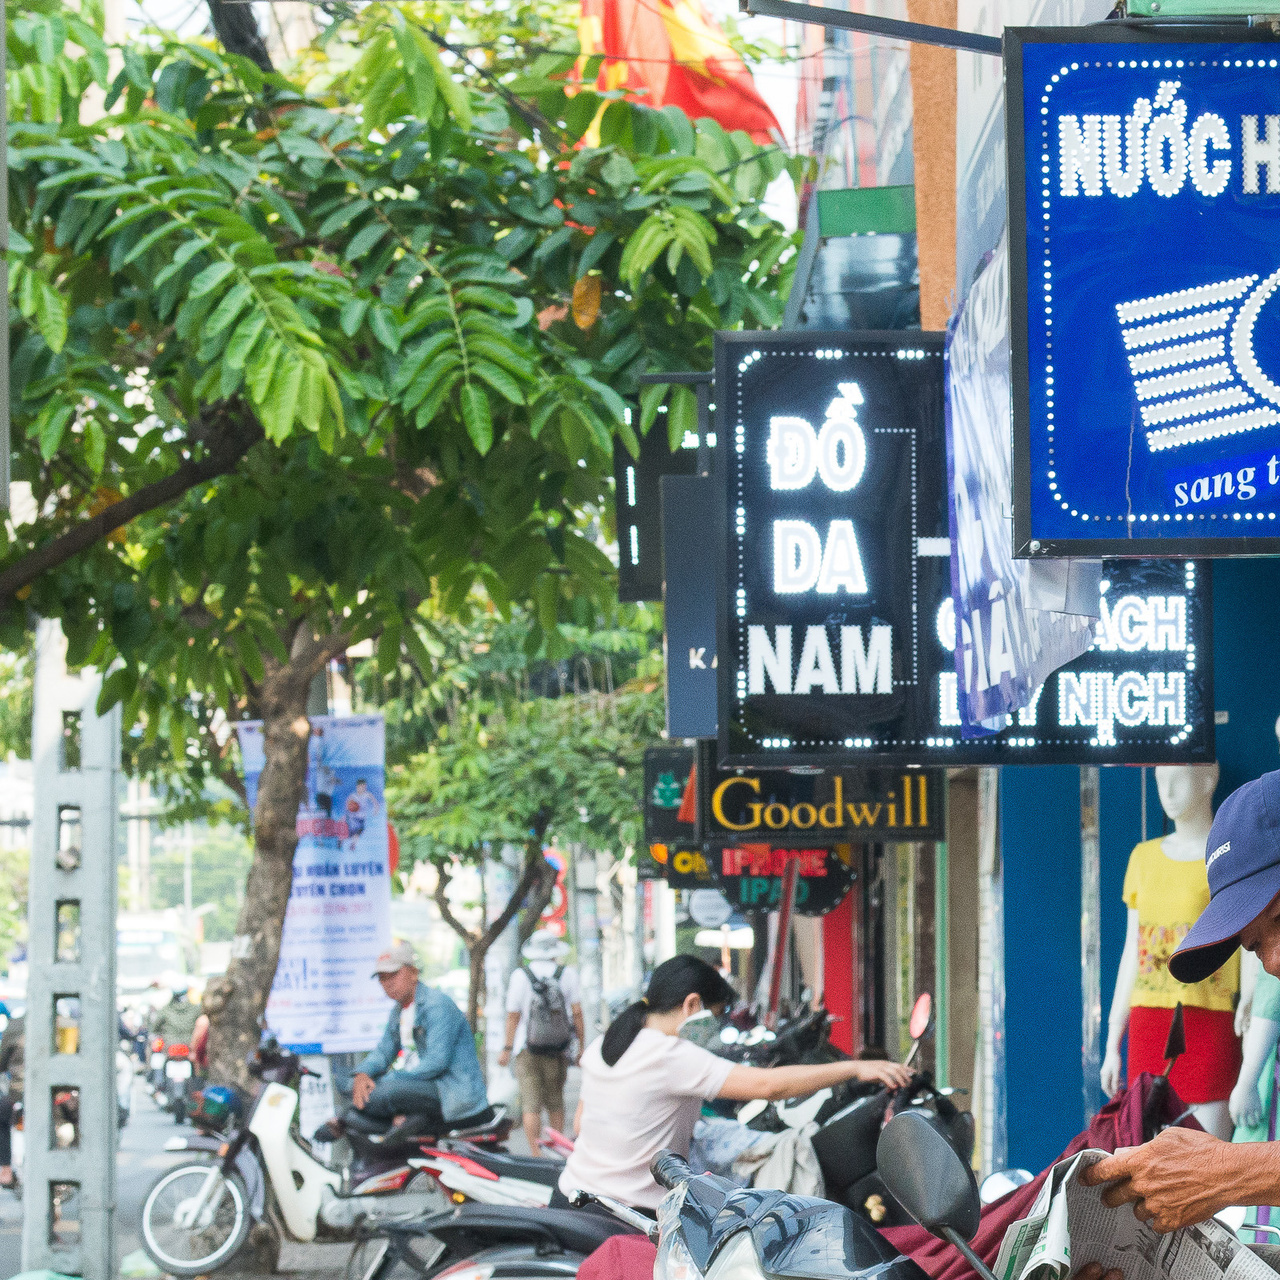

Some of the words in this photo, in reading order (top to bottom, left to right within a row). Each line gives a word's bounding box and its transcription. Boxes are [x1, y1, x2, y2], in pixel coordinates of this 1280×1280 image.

[1057, 79, 1233, 198] NƯỚC
[766, 381, 868, 493] ĐỒ
[1173, 461, 1258, 508] sang
[771, 518, 868, 595] DA
[1087, 580, 1187, 652] ÁCH
[747, 623, 894, 696] NAM
[1058, 670, 1187, 744] NỊCH
[711, 775, 929, 831] Goodwill
